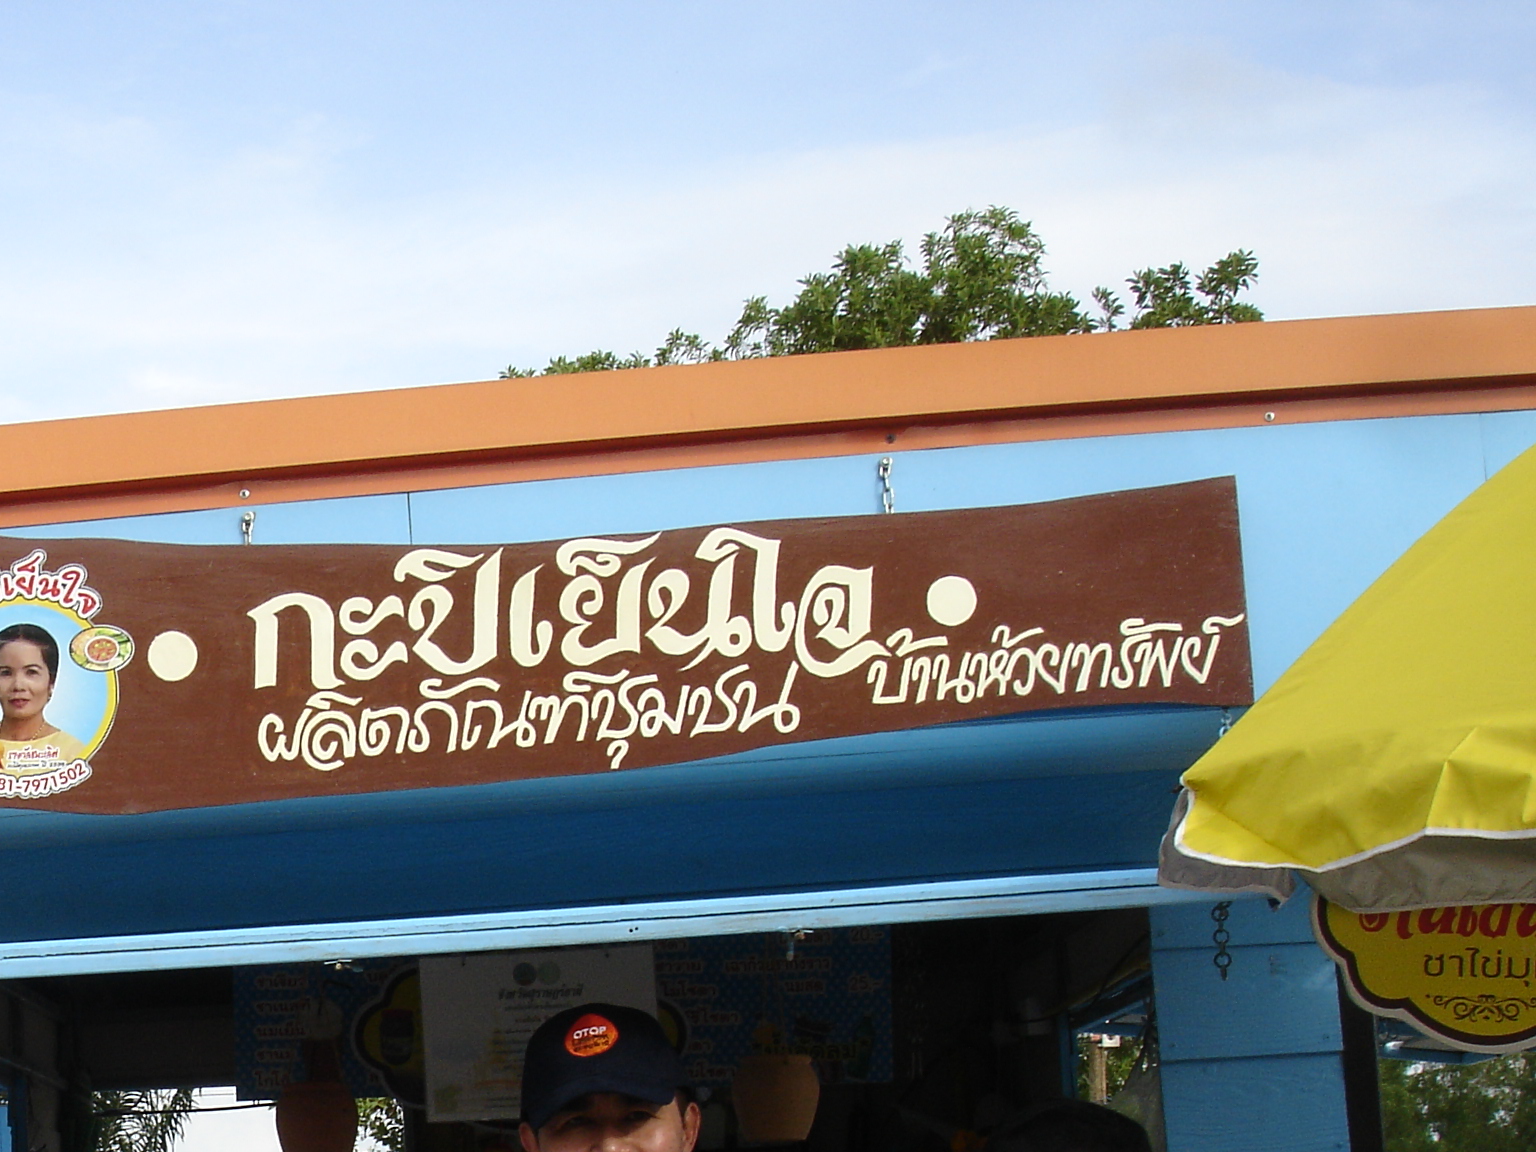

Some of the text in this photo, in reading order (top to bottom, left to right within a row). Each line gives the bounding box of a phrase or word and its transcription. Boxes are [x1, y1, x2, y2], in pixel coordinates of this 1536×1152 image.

[867, 613, 1244, 704] บ้านห้วยทรัพย์
[258, 661, 801, 769] ผลิตภัณฑ์ชุมชน
[1424, 947, 1536, 988] ชาไข่มุ
[573, 1026, 607, 1040] OTOP
